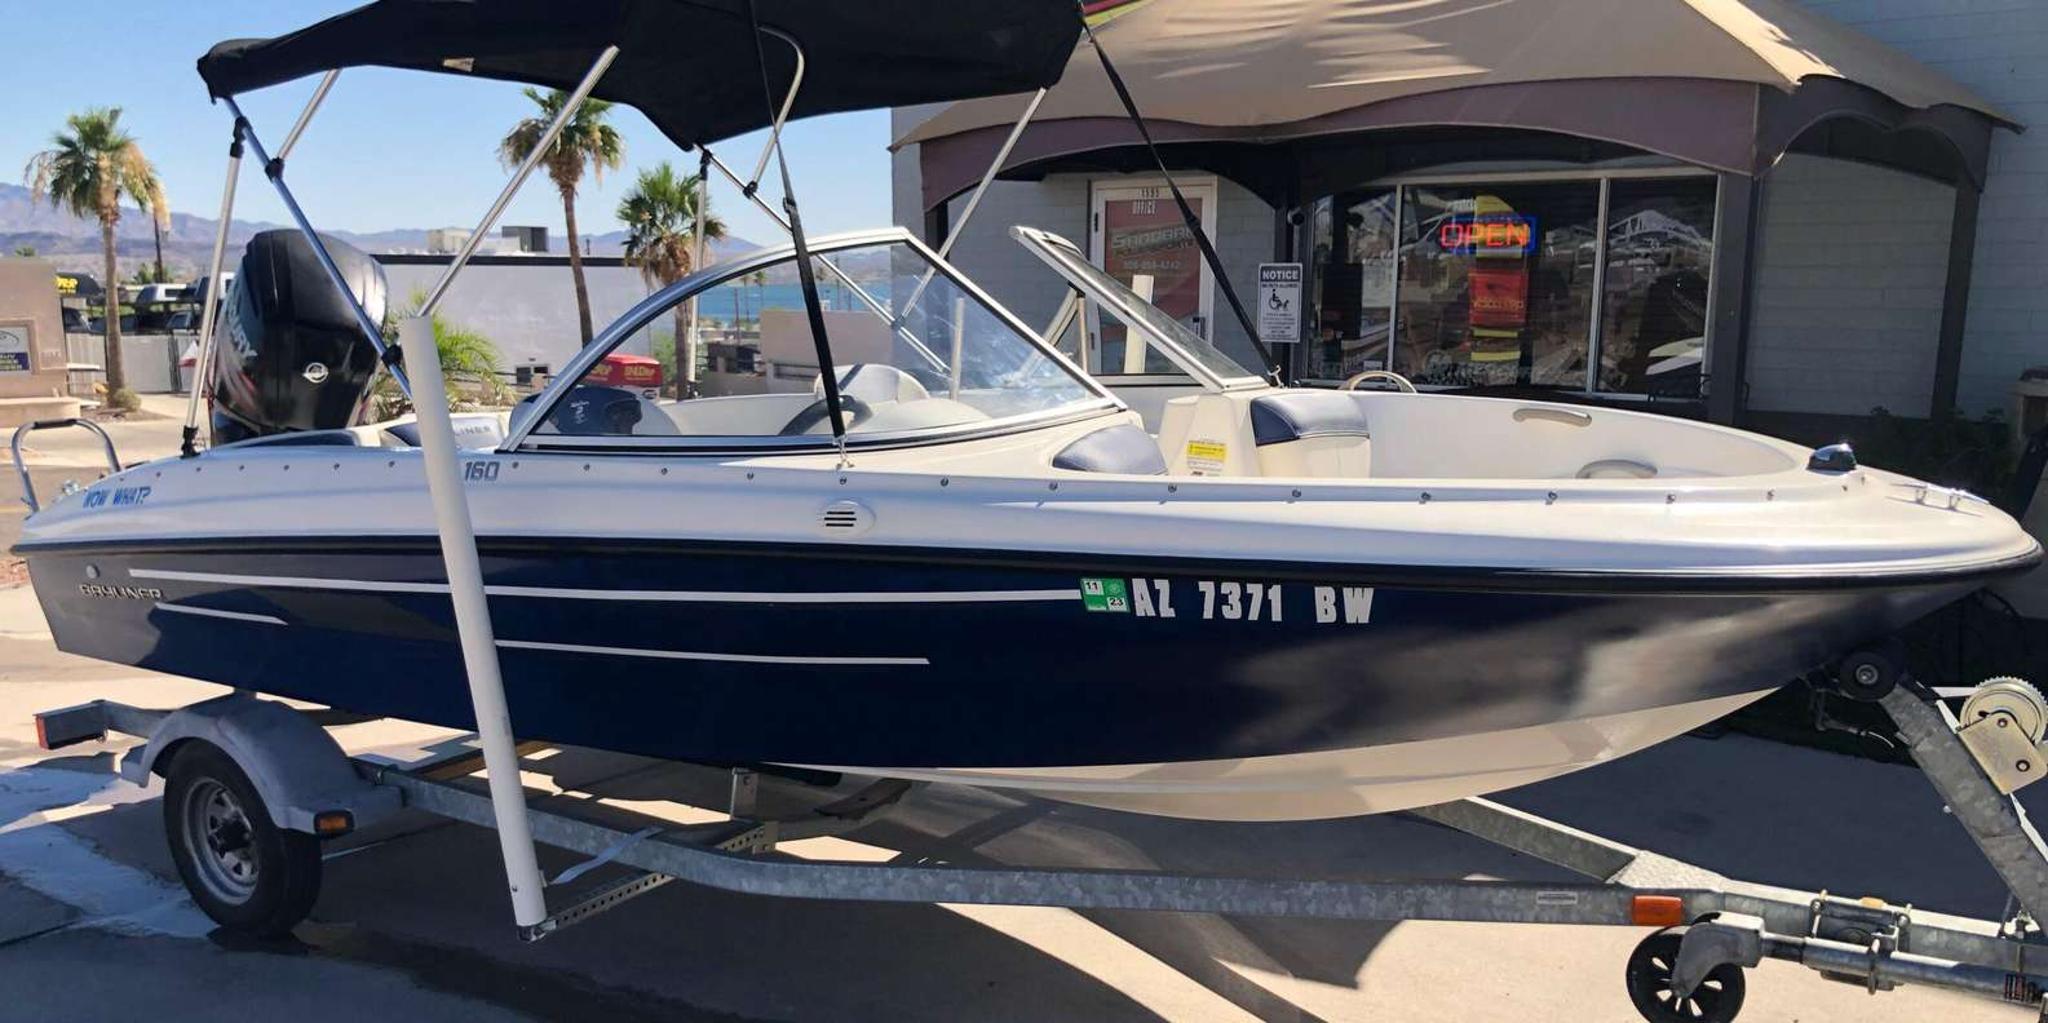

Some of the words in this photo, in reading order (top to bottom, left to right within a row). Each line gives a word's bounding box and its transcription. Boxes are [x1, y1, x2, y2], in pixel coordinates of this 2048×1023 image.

[1131, 199, 1156, 214] OFFICE
[1440, 223, 1530, 247] OPEN
[1262, 270, 1299, 280] NOTICE
[465, 461, 500, 480] 160
[113, 486, 151, 505] WHAT?
[79, 584, 163, 600] BAYLINER
[1086, 581, 1098, 590] 11
[1110, 598, 1124, 607] 23
[1131, 578, 1176, 618] AZ
[1198, 581, 1283, 622] 7371
[1314, 586, 1375, 624] BW
